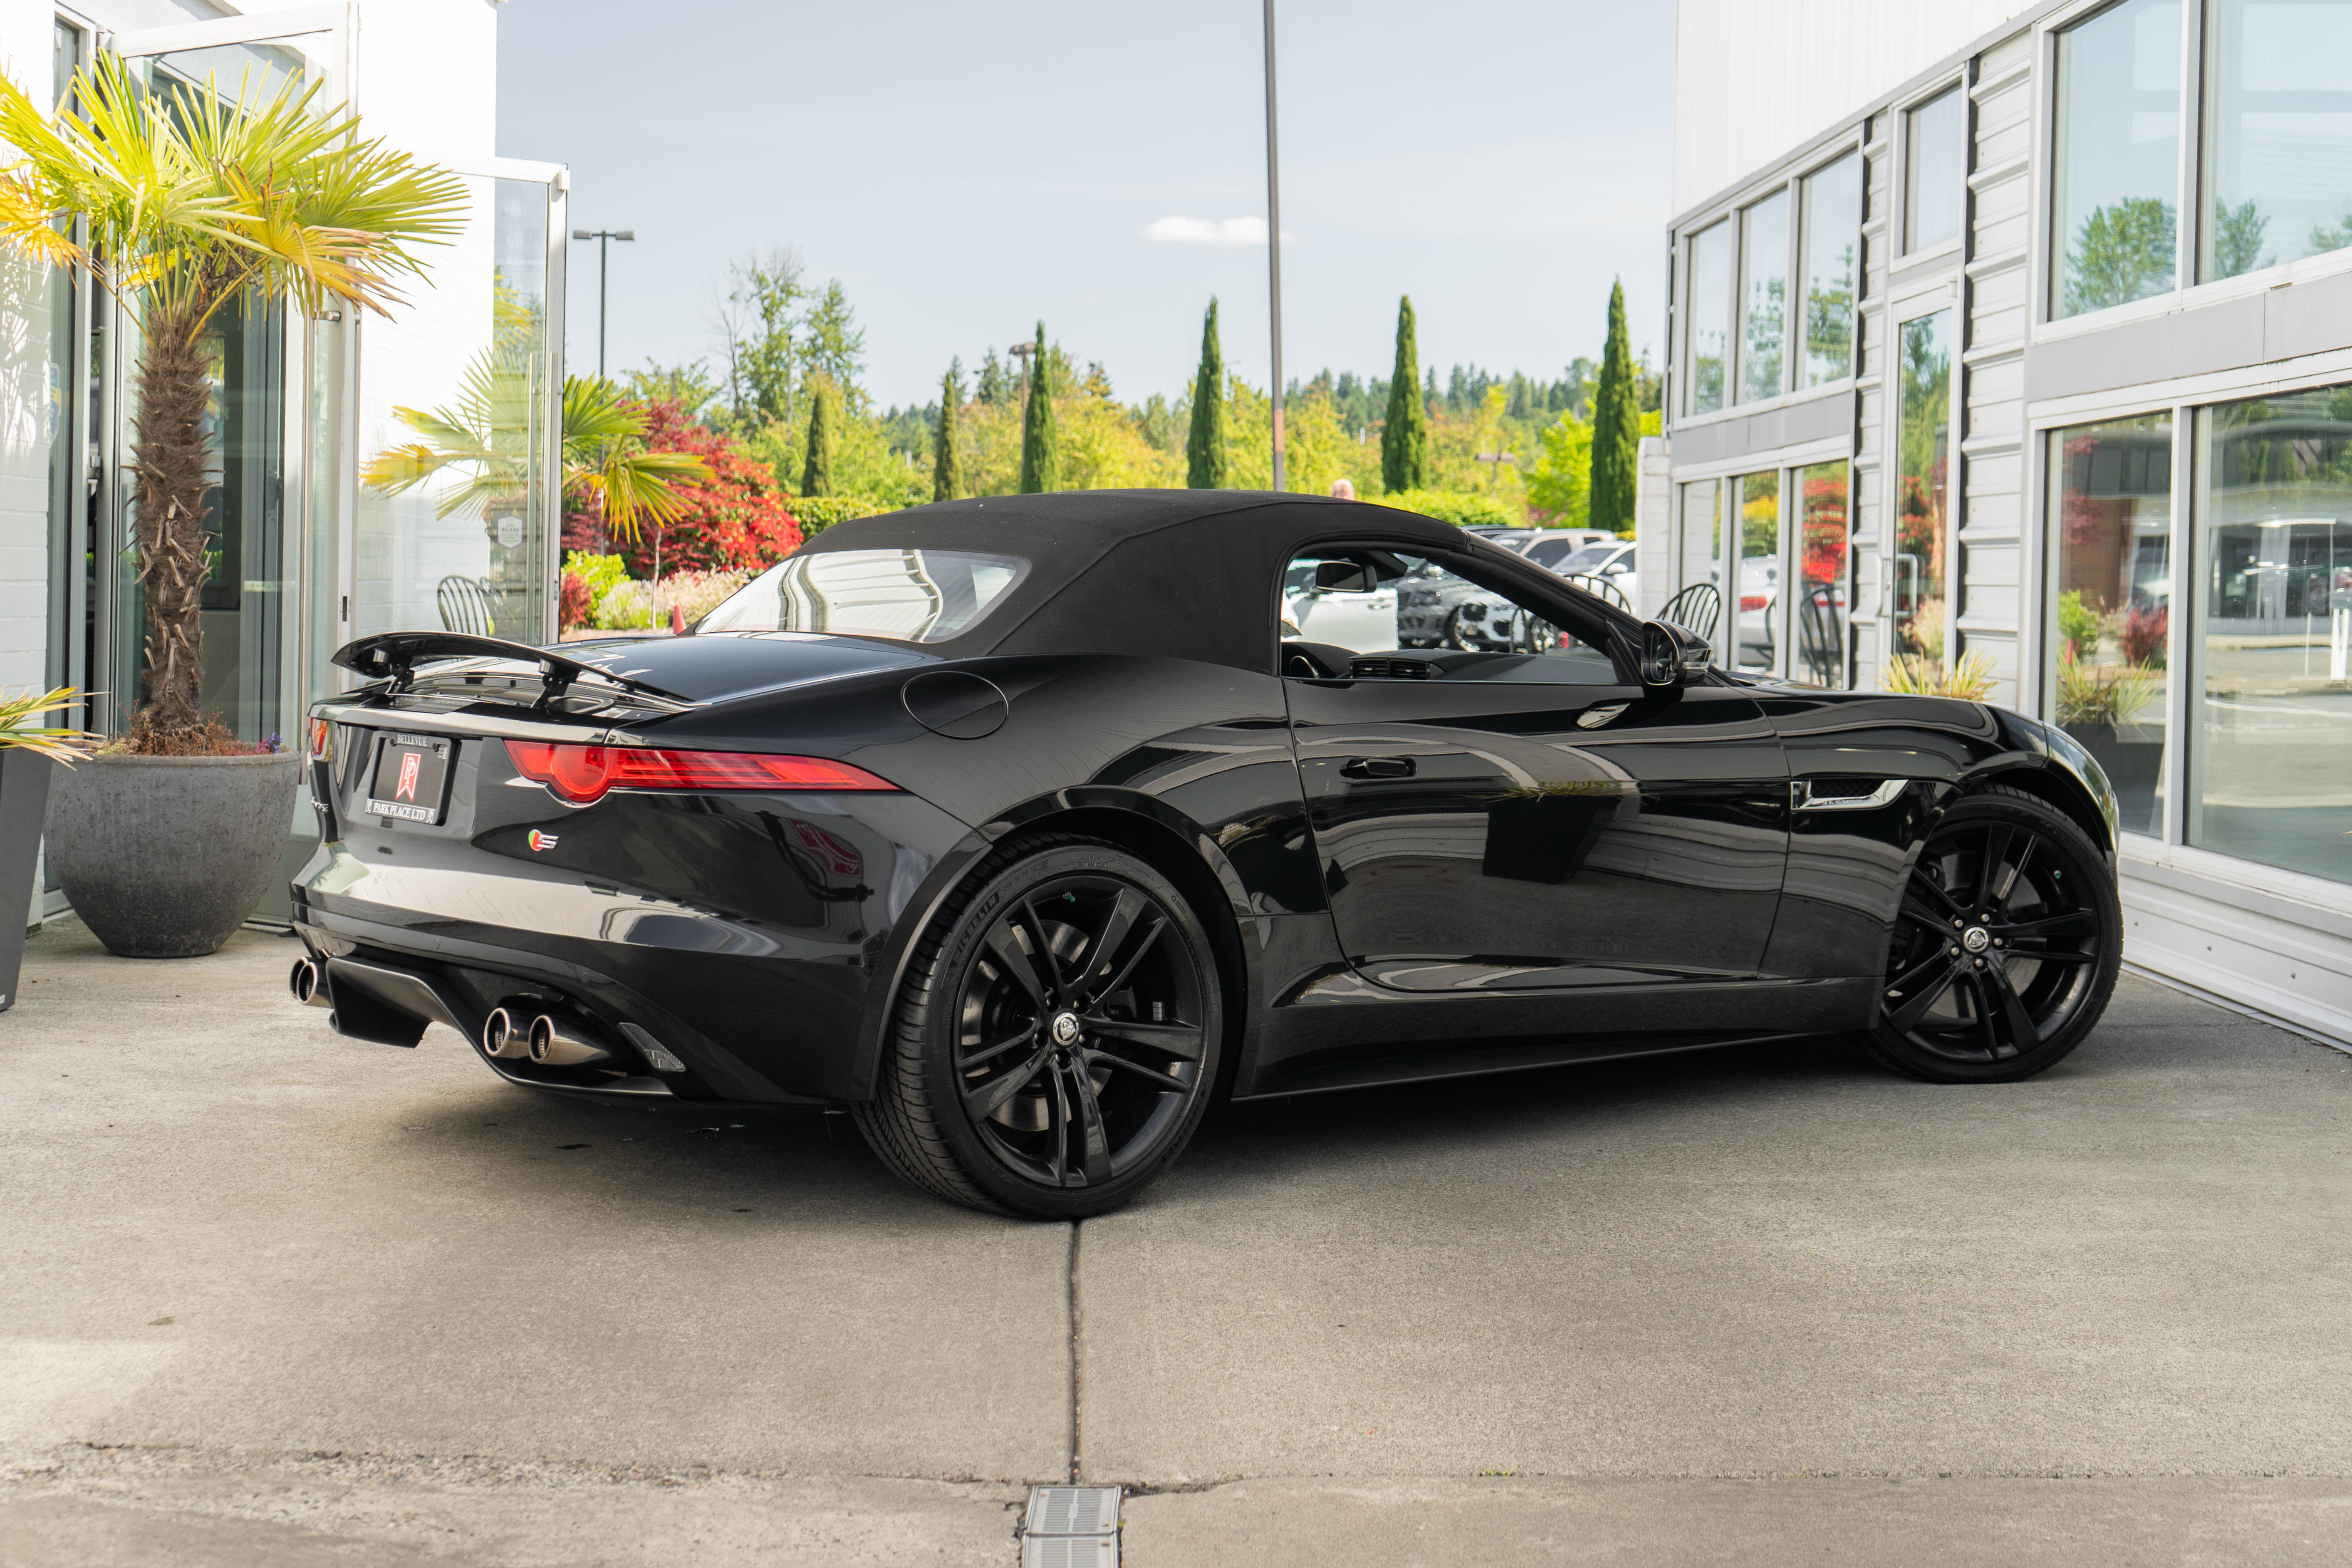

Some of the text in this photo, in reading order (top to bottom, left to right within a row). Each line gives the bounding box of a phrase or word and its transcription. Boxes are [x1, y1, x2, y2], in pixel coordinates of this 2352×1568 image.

[397, 734, 427, 746] BELLEVUE
[373, 802, 389, 815] PARK
[389, 805, 410, 818] PLACE
[410, 808, 426, 820] LTD
[537, 835, 559, 849] S
[952, 895, 997, 962] MICHELIN
